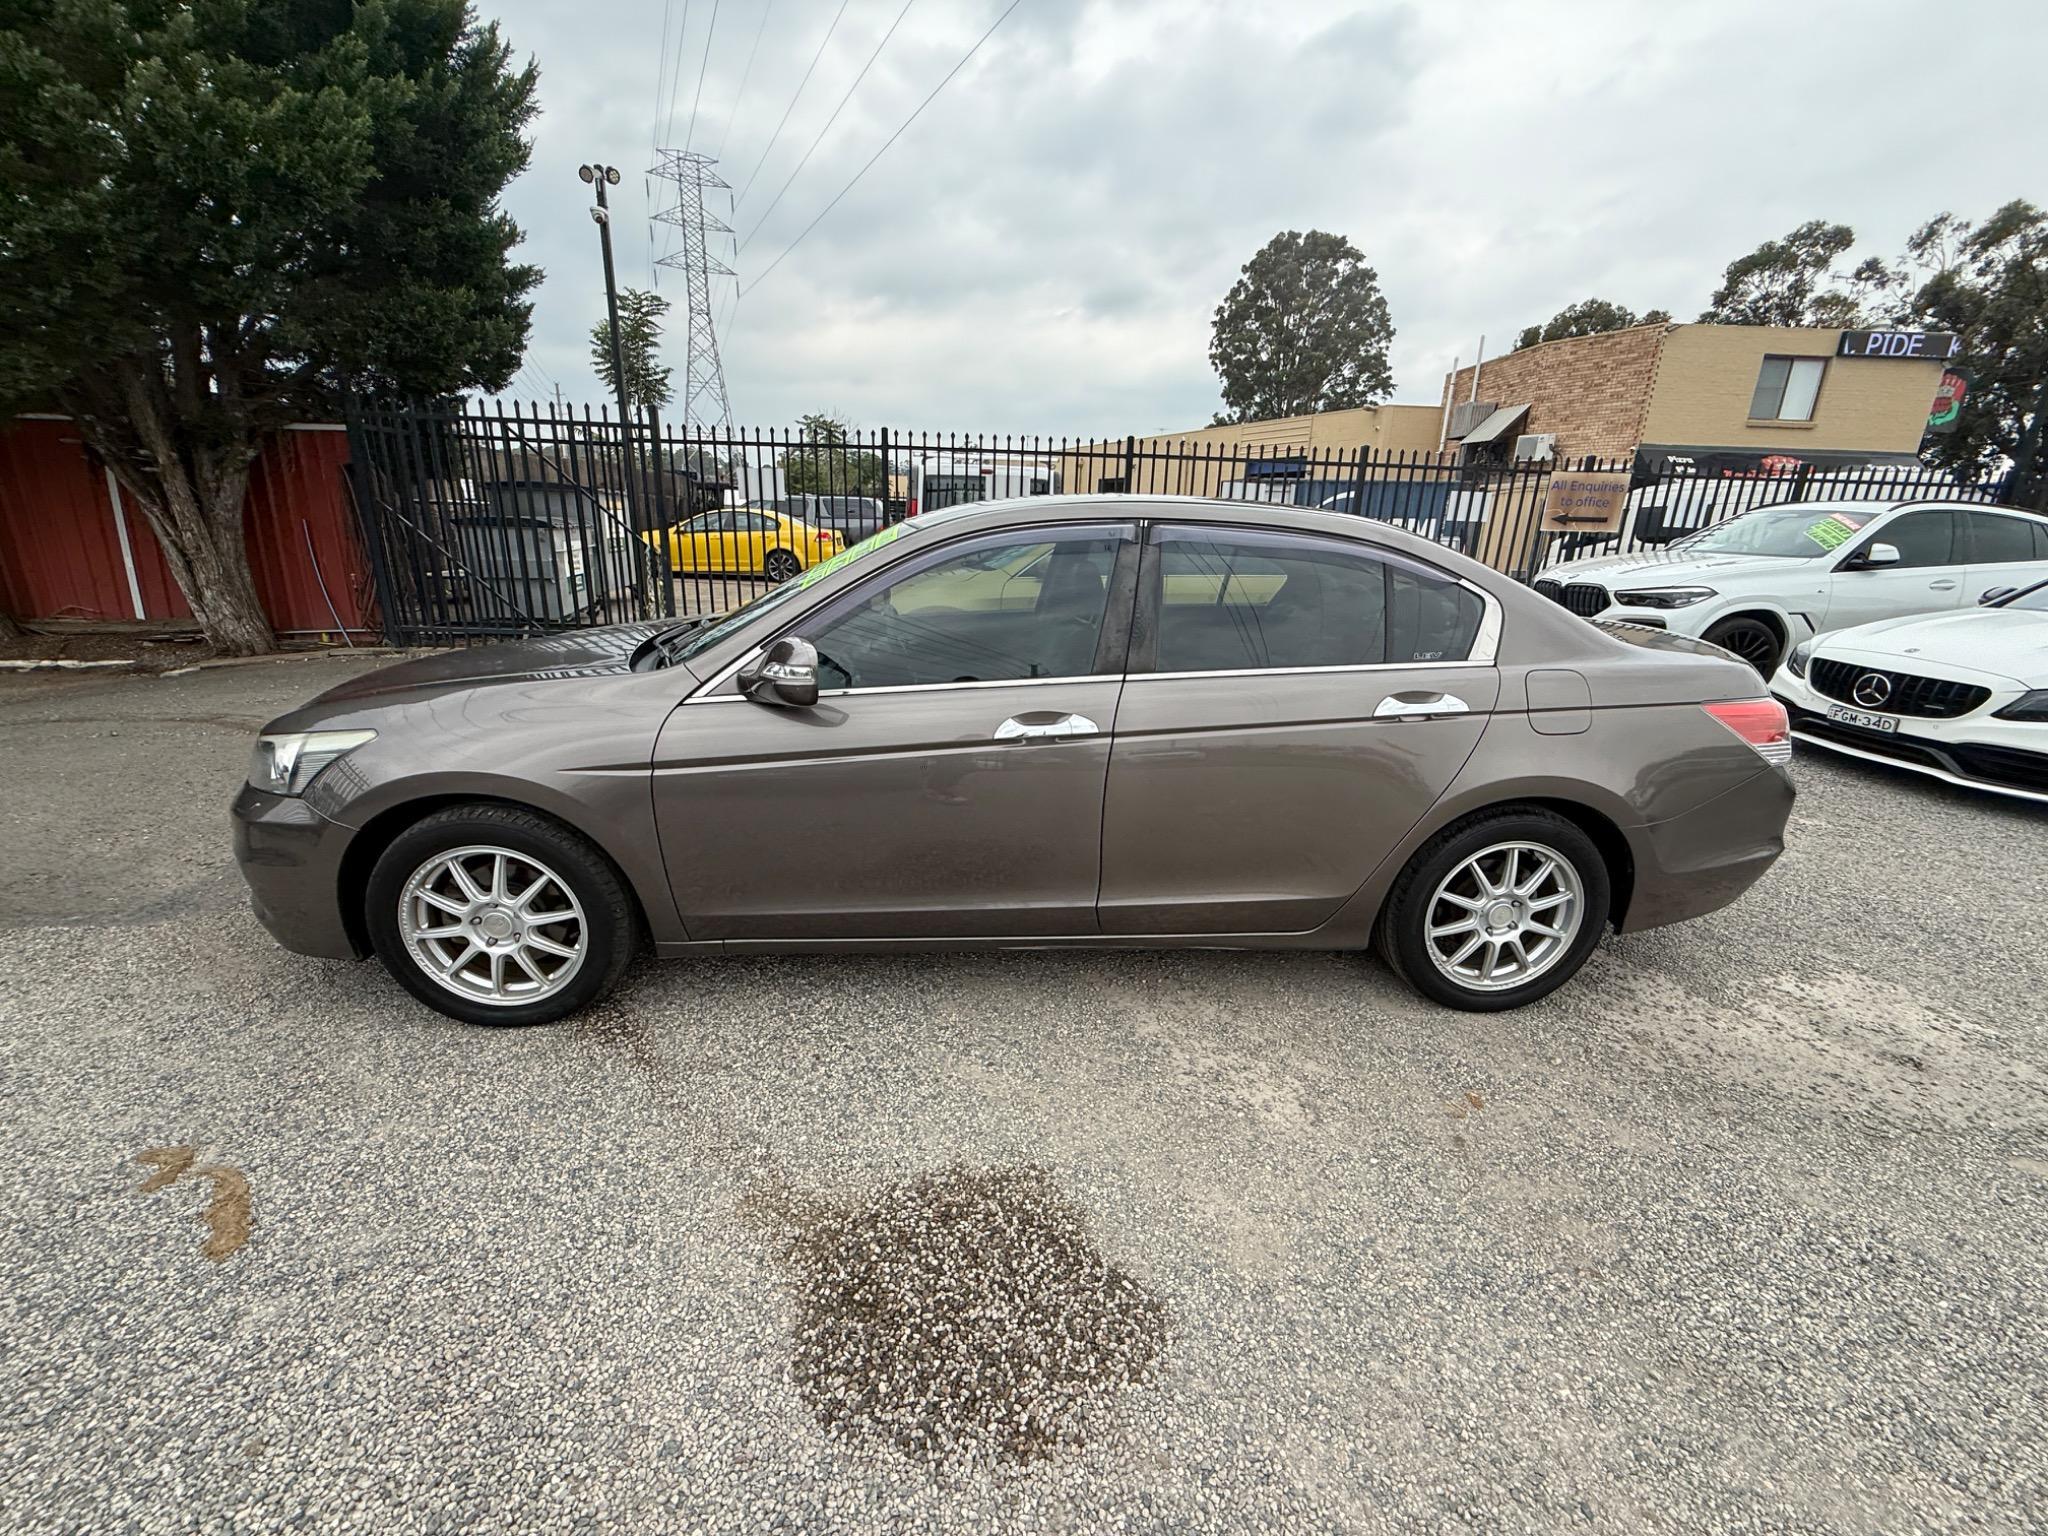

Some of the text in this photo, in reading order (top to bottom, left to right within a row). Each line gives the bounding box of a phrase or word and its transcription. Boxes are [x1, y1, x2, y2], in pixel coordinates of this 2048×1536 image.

[1551, 480, 1625, 494] All Enquiries
[1560, 495, 1610, 508] to office
